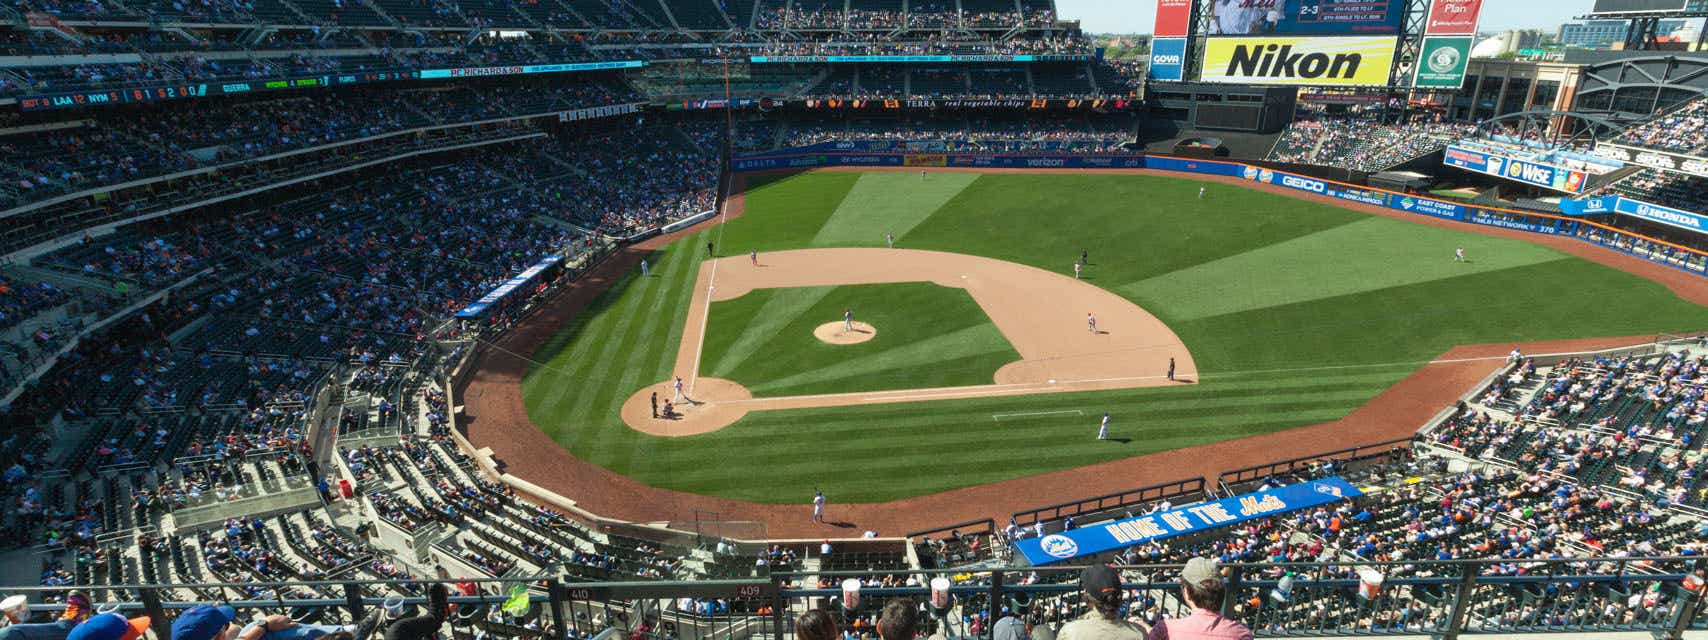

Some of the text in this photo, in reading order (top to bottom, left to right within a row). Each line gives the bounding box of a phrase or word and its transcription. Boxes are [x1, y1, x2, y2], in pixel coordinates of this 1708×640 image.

[1300, 6, 1319, 14] 2-3
[1444, 4, 1467, 13] Plan
[1153, 55, 1180, 64] GOYA
[1225, 44, 1362, 79] Nikon
[223, 83, 250, 93] GUERRA
[53, 97, 73, 106] LAA
[73, 96, 86, 105] 12
[88, 94, 109, 104] NYM
[144, 89, 151, 99] 1
[167, 88, 175, 97] 2
[906, 100, 936, 108] TERRA
[964, 100, 1001, 109] vegetable
[1003, 100, 1025, 109] chips
[747, 160, 777, 168] DELTA
[1027, 156, 1065, 167] verizon
[1282, 175, 1325, 192] GEICO
[1416, 205, 1437, 213] POWER
[1418, 199, 1456, 211] EAST COAST
[1649, 208, 1701, 227] HONDA
[1477, 217, 1529, 231] MLB NETWORK
[1540, 225, 1554, 234] 370
[1105, 494, 1287, 544] HOME OF THE Mets
[571, 589, 588, 600] 410
[740, 586, 760, 596] 409
